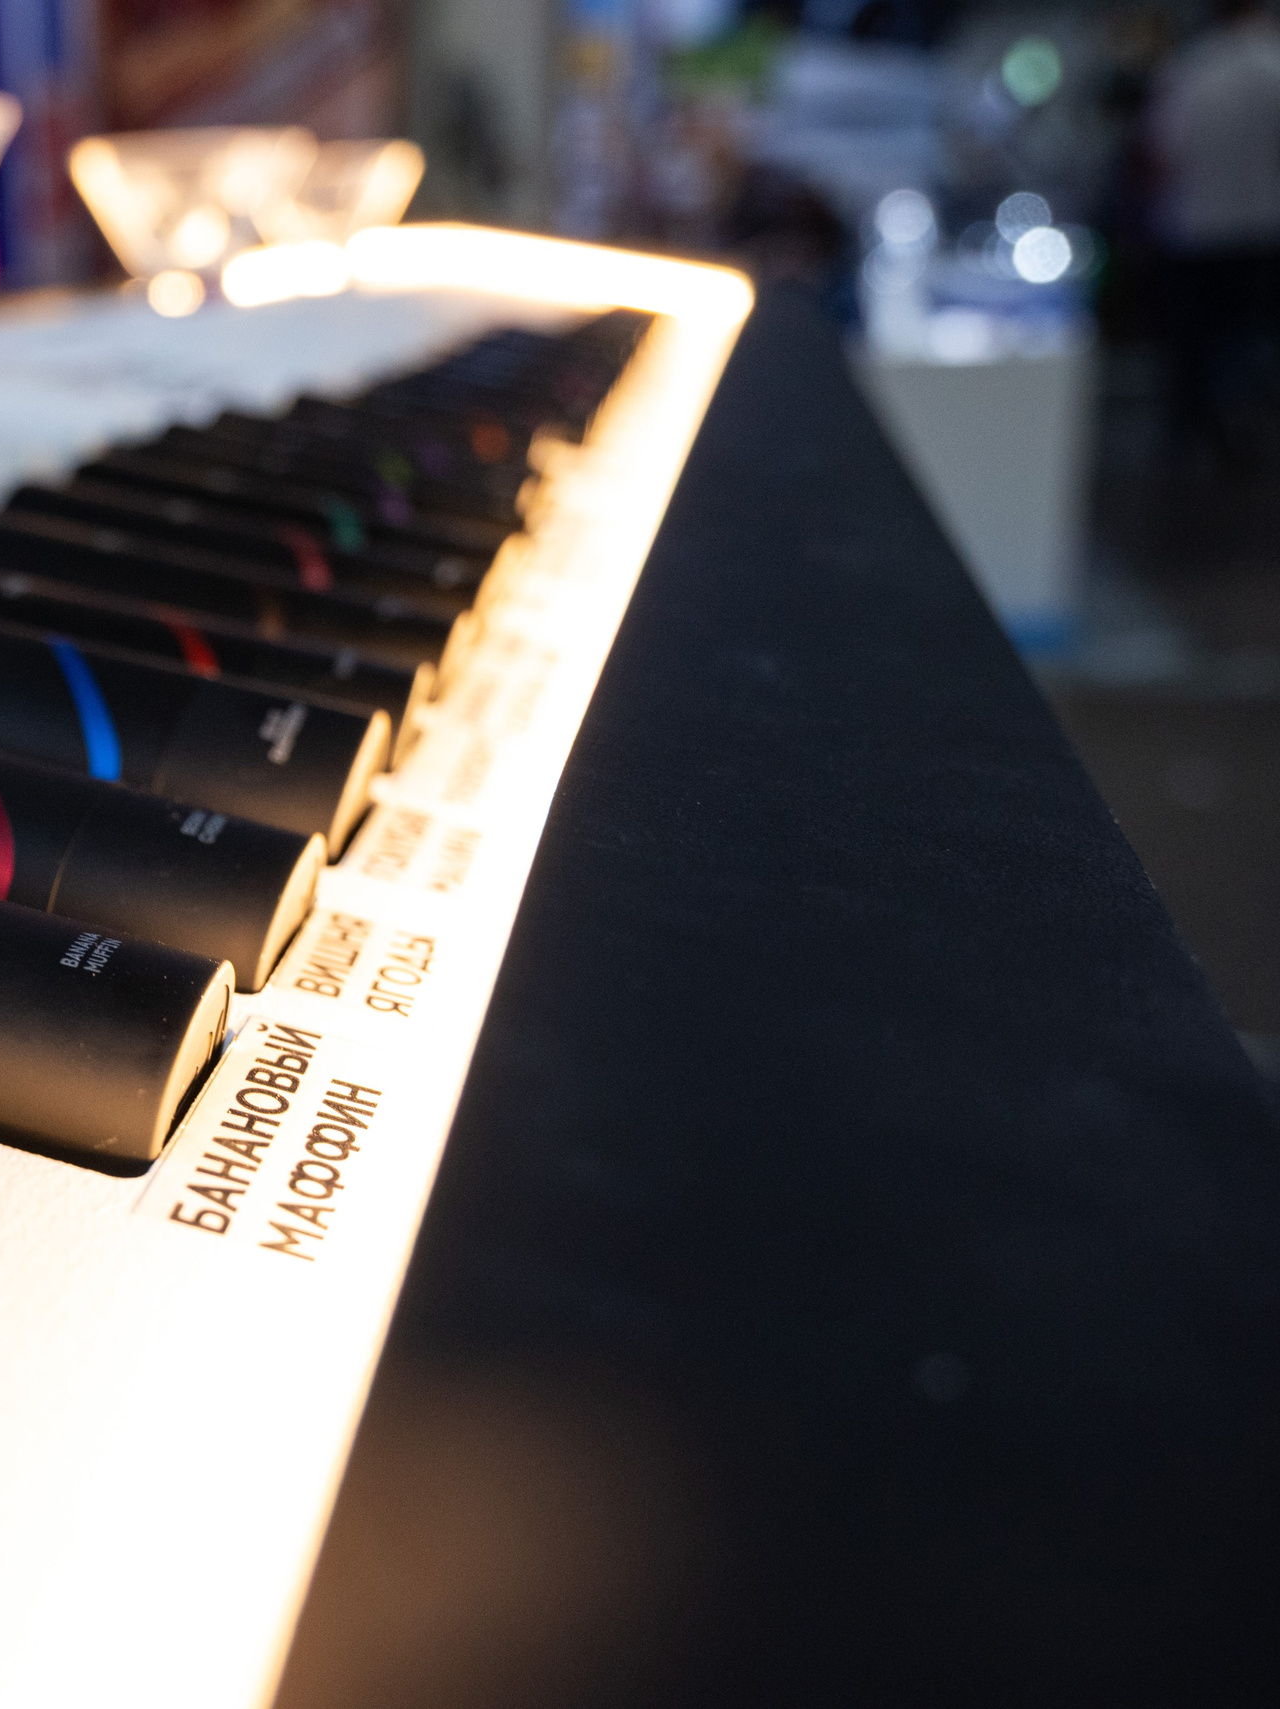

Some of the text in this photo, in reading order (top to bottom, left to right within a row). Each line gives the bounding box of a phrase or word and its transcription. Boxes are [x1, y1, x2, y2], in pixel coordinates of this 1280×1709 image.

[60, 931, 102, 969] BANANA
[82, 936, 123, 974] MUFFIN
[366, 929, 438, 1017] ЯГОДЫ
[169, 1022, 324, 1235] БАНАНОВЫЙ
[258, 1078, 383, 1262] МАФФИН
